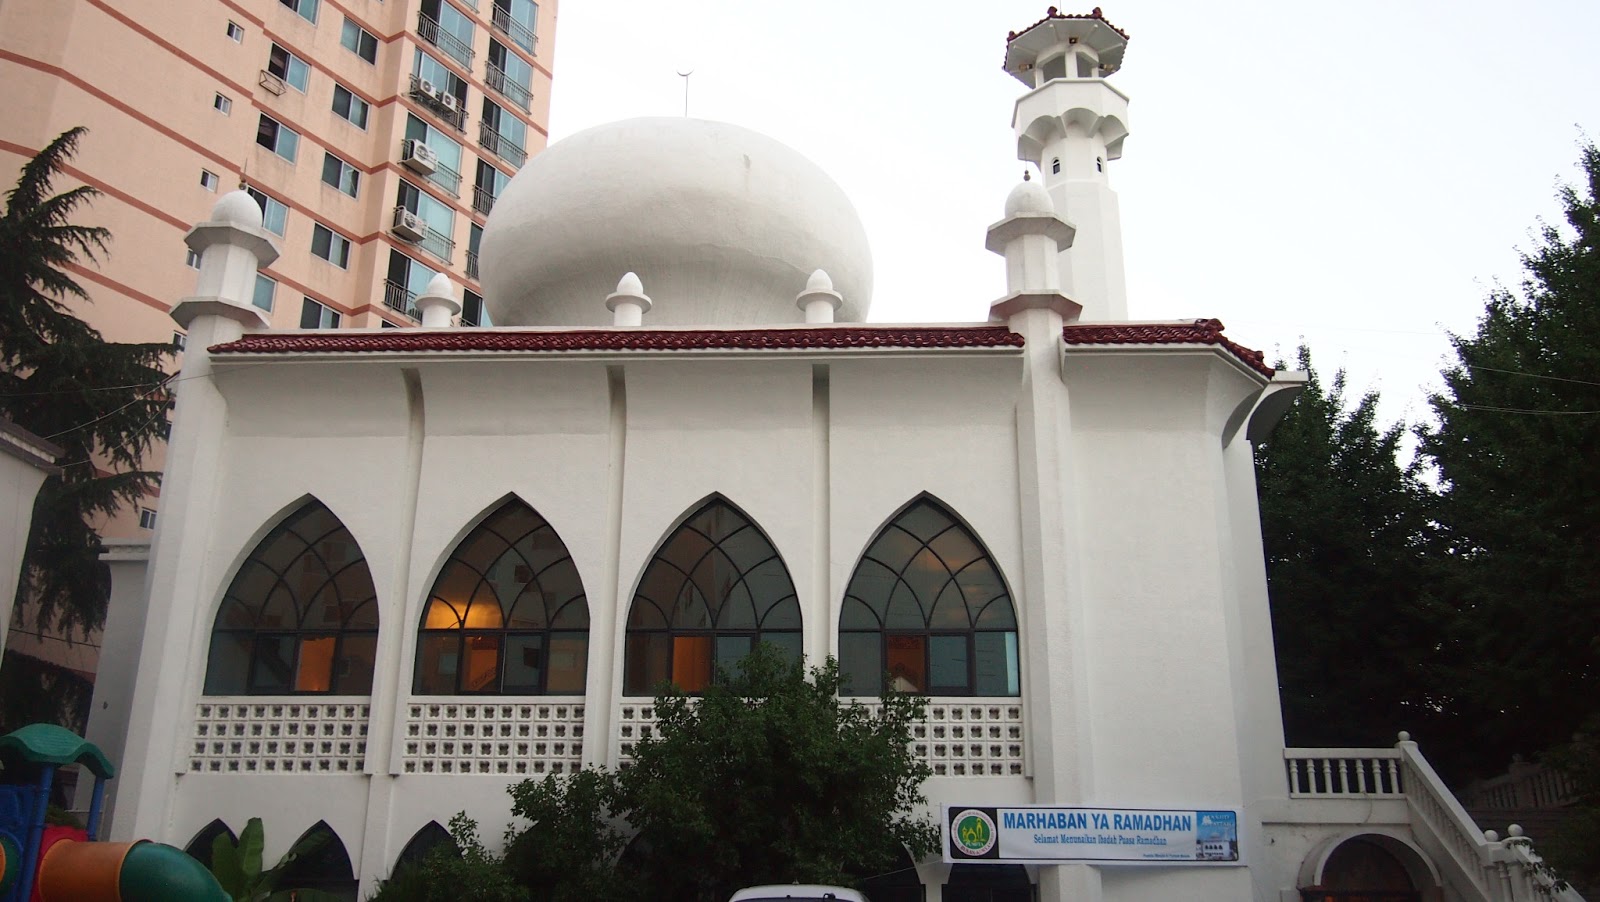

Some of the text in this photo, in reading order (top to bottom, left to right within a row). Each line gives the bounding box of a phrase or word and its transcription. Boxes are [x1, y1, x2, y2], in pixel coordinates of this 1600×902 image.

[1003, 812, 1087, 829] MARHABAN
[1091, 812, 1110, 830] YA
[1113, 813, 1191, 831] RAMADHAN
[1033, 833, 1167, 846] Selamat Menunaikan Ibadah Puasa Ramadhan
